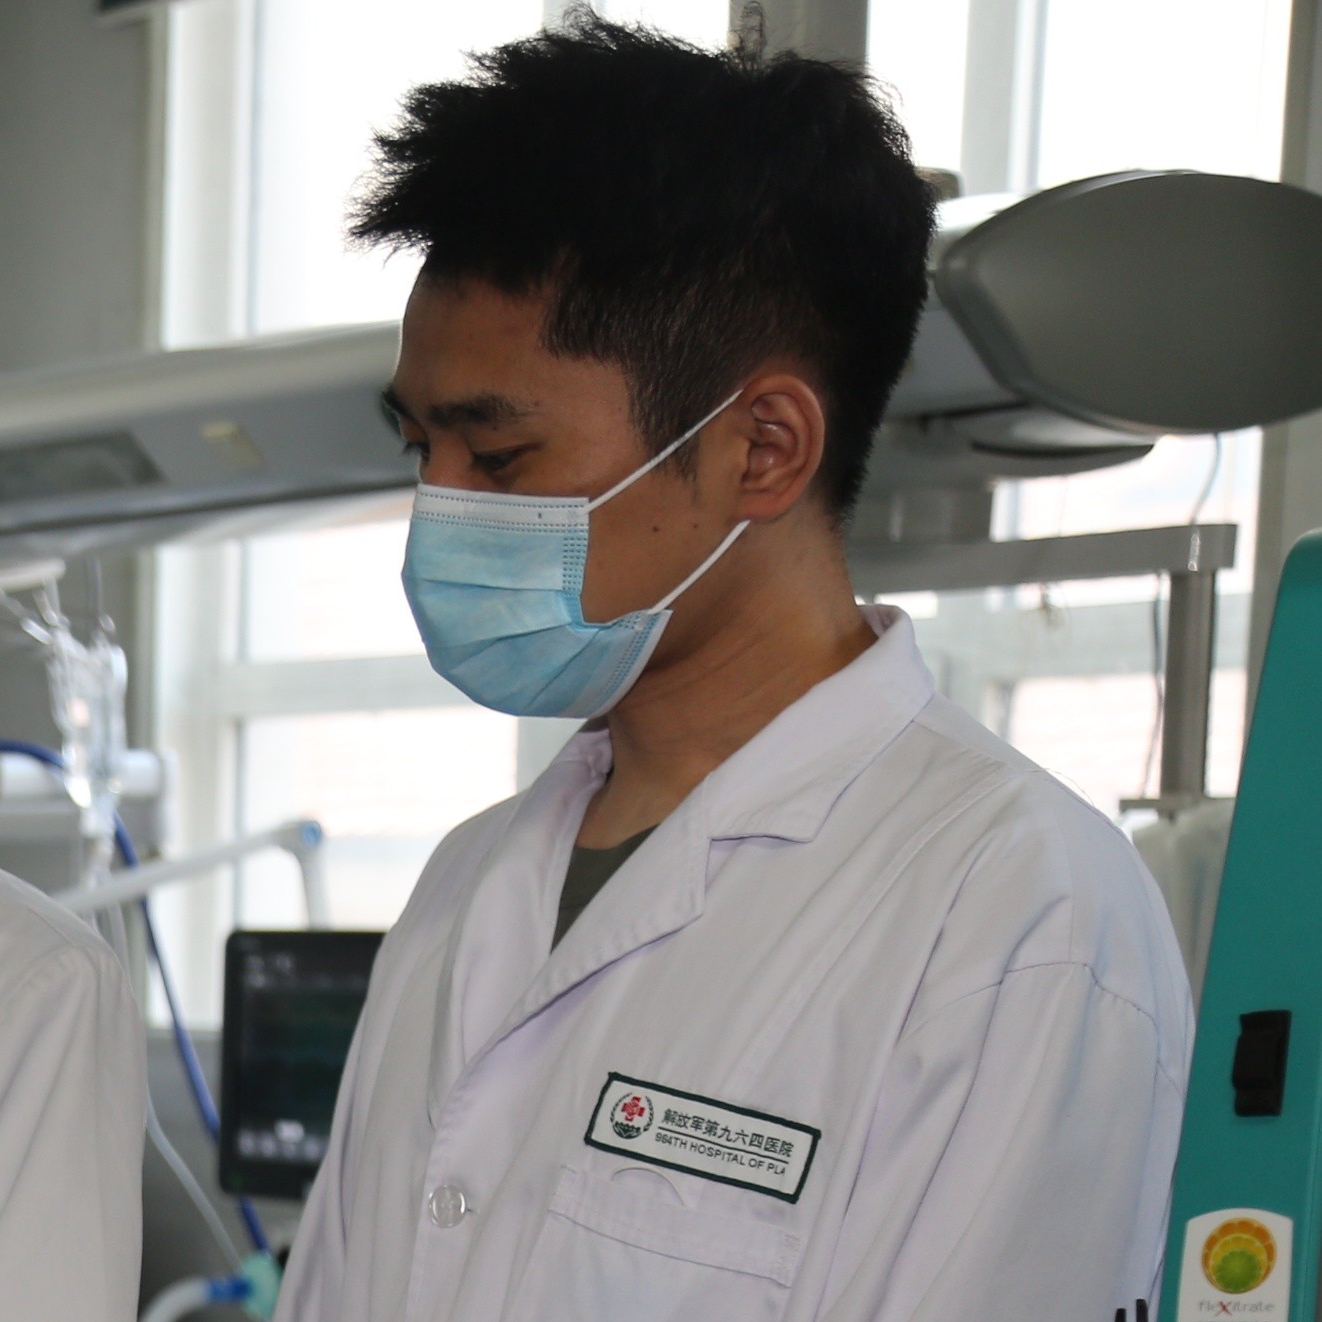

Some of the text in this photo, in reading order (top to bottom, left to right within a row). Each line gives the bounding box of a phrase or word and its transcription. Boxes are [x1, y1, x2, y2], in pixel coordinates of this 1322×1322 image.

[655, 1131, 785, 1176] 964TH HOSPITAL OF PLA
[661, 1108, 795, 1158] 解放军第九六四医院
